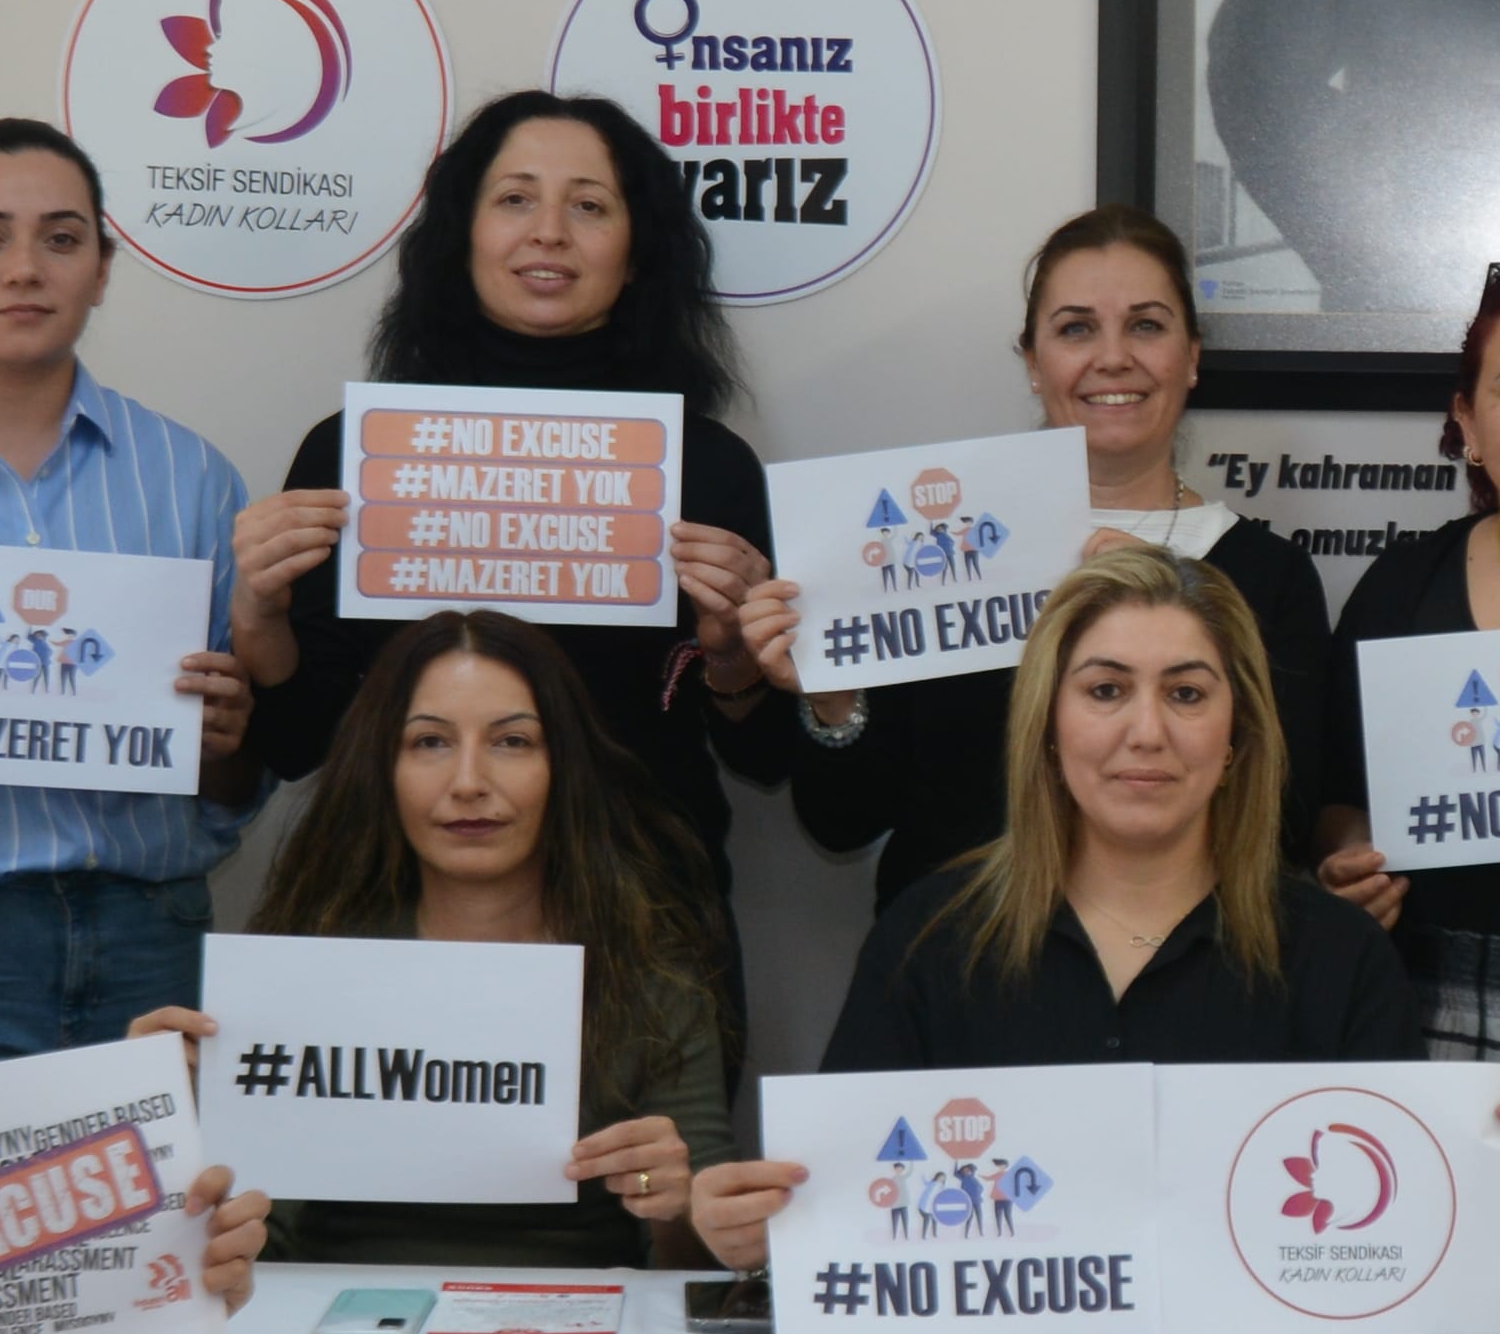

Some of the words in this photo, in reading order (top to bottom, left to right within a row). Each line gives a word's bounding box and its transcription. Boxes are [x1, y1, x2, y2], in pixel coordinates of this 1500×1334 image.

[657, 84, 847, 147] birlikte
[146, 163, 227, 193] TEKSİF
[232, 165, 354, 198] SENDİKASI
[145, 200, 233, 231] KADIN
[236, 203, 359, 235] KOLLARI
[410, 415, 494, 458] #NO
[501, 419, 617, 460] EXCUSE
[391, 462, 564, 505] #MAZERET
[573, 467, 632, 506] YOK
[912, 481, 958, 506] STOP
[1278, 454, 1457, 491] kahraman
[408, 509, 491, 551] #NO
[498, 513, 614, 553] EXCUSE
[389, 556, 561, 598] #MAZERET
[571, 560, 629, 599] YOK
[21, 586, 59, 613] DUR
[823, 611, 927, 668] #NO
[935, 588, 1052, 652] EXCU
[103, 723, 176, 769] YOK
[235, 1042, 546, 1106] #ALLWomen
[937, 1114, 992, 1143] STOP
[1278, 1244, 1326, 1261] TEKSİF
[1328, 1244, 1403, 1261] SENDİKASI
[813, 1258, 939, 1317] #NO
[954, 1253, 1135, 1316] EXCUSE
[1277, 1266, 1331, 1283] KADIN
[1333, 1267, 1407, 1283] KOLLARI
